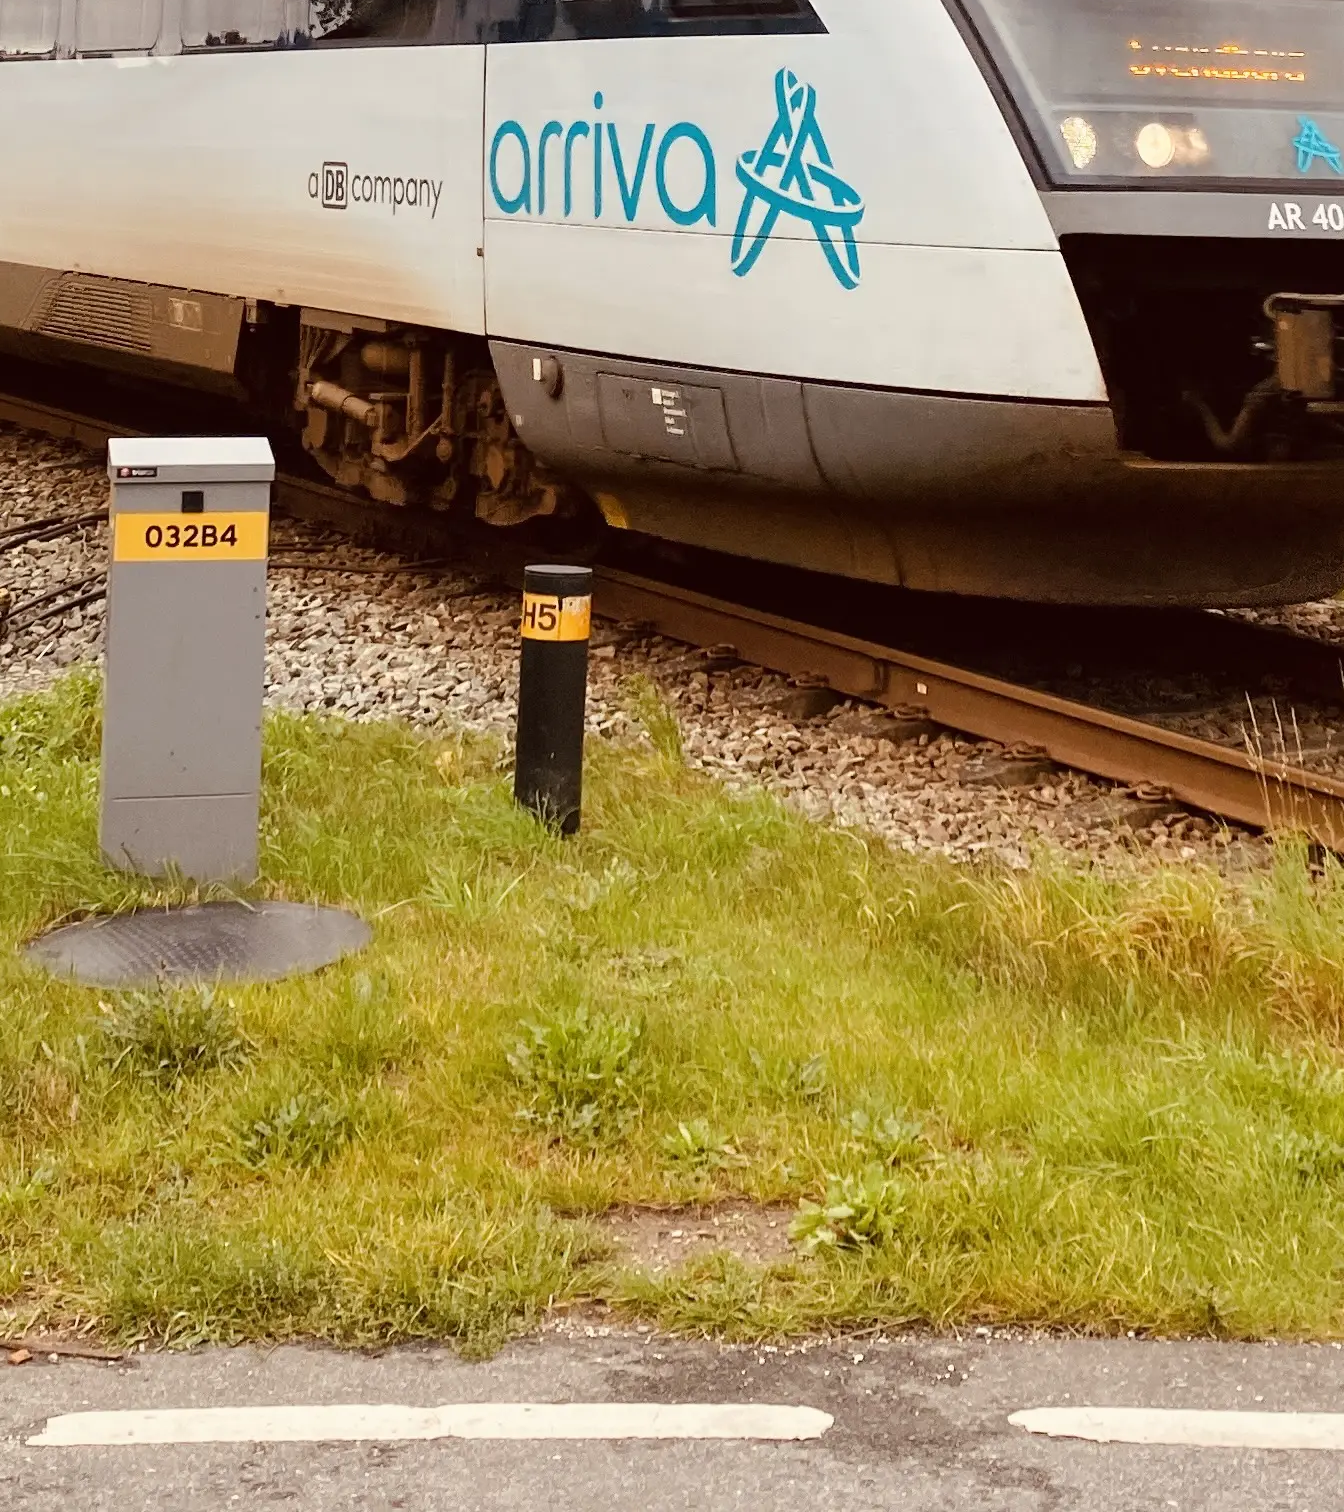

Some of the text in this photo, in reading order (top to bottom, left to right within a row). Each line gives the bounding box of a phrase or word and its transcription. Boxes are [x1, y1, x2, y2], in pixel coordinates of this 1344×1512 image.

[490, 91, 716, 228] arriva
[308, 167, 443, 219] a DB company
[1268, 202, 1306, 230] AR
[145, 524, 238, 548] 032B4
